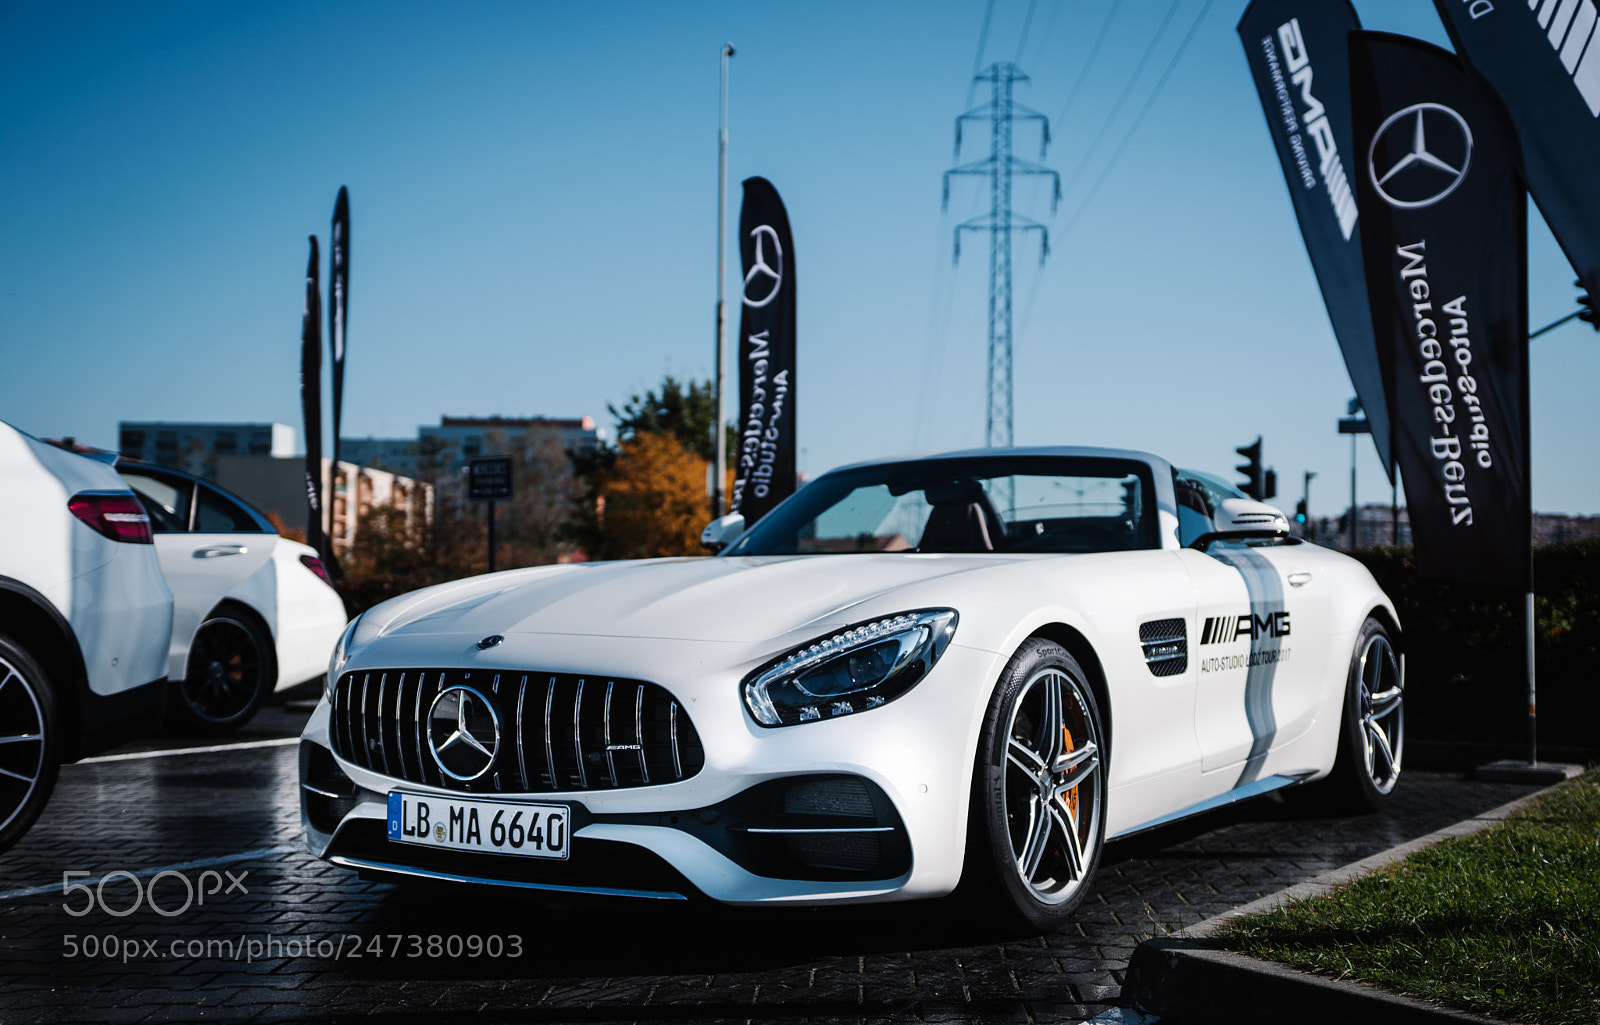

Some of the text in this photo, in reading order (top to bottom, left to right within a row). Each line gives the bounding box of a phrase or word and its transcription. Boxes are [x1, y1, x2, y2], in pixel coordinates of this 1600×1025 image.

[1233, 611, 1291, 642] AMG
[1201, 654, 1244, 674] AUTO-STUDIO
[1261, 649, 1276, 665] TOUR
[392, 820, 398, 831] D
[402, 800, 564, 852] LB MA 6640
